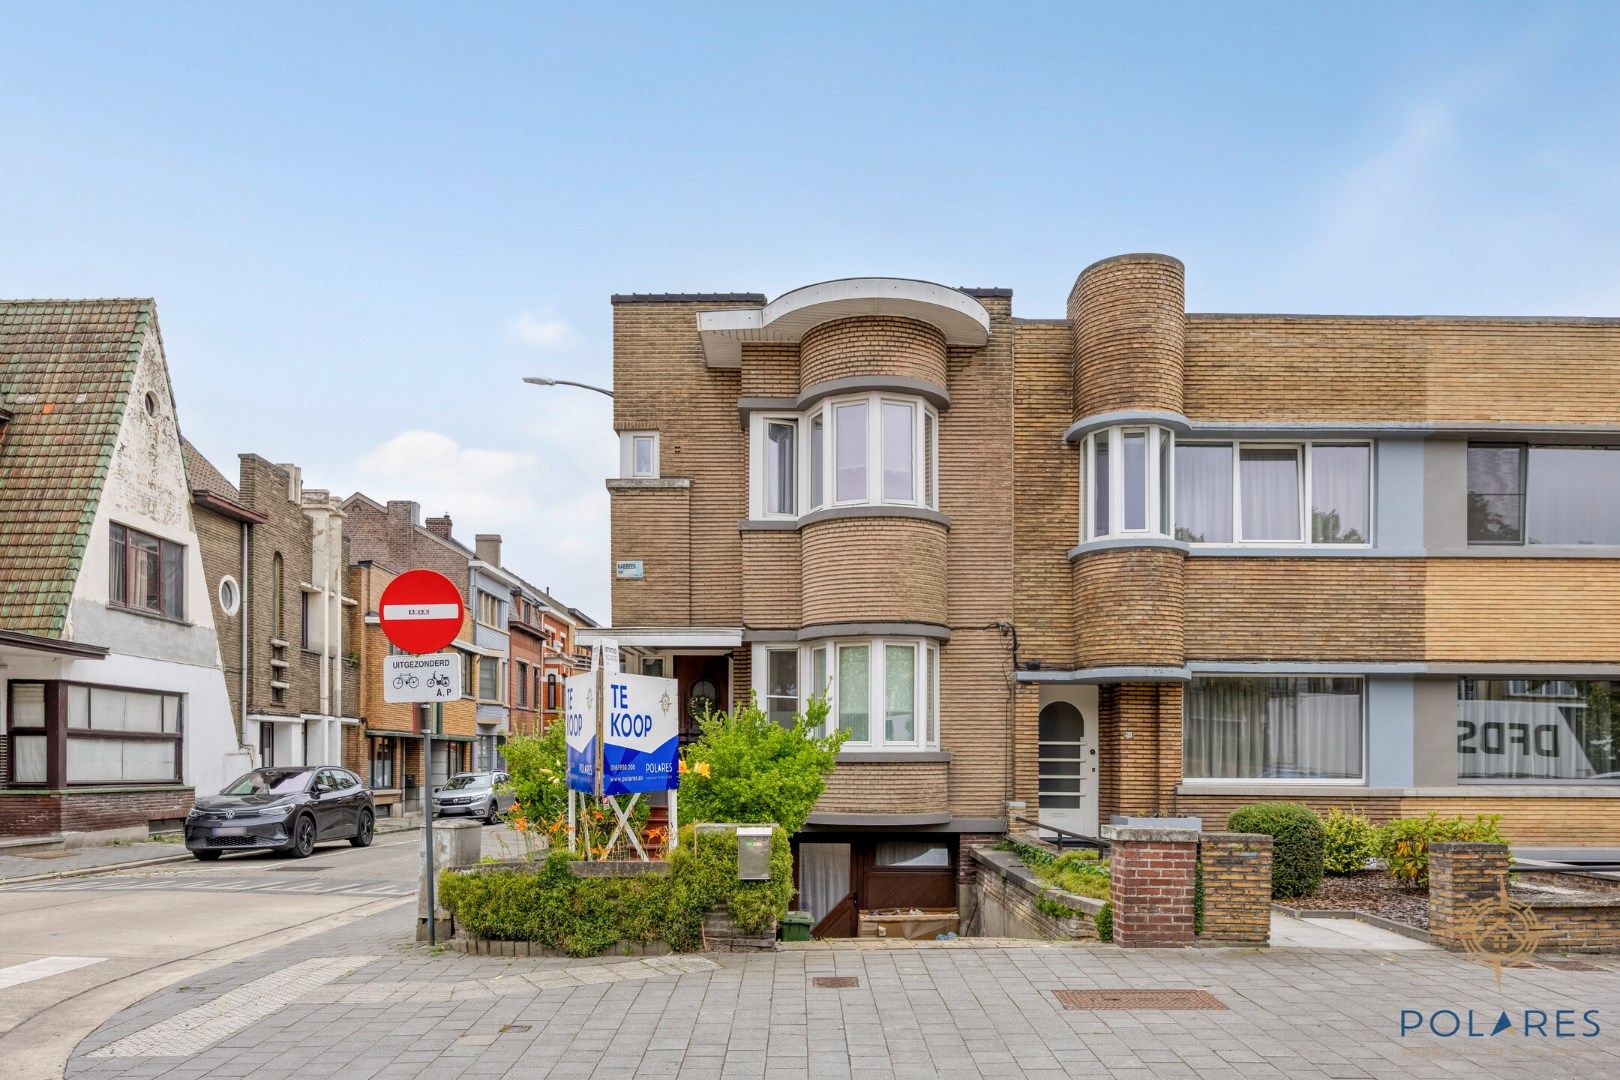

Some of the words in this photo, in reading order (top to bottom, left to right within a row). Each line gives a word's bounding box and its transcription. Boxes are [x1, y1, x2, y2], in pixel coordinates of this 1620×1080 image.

[392, 659, 450, 669] UITGEZONDERD
[446, 688, 452, 696] P
[610, 684, 628, 709] TE
[610, 713, 653, 738] KOOP
[645, 762, 673, 773] POLARES
